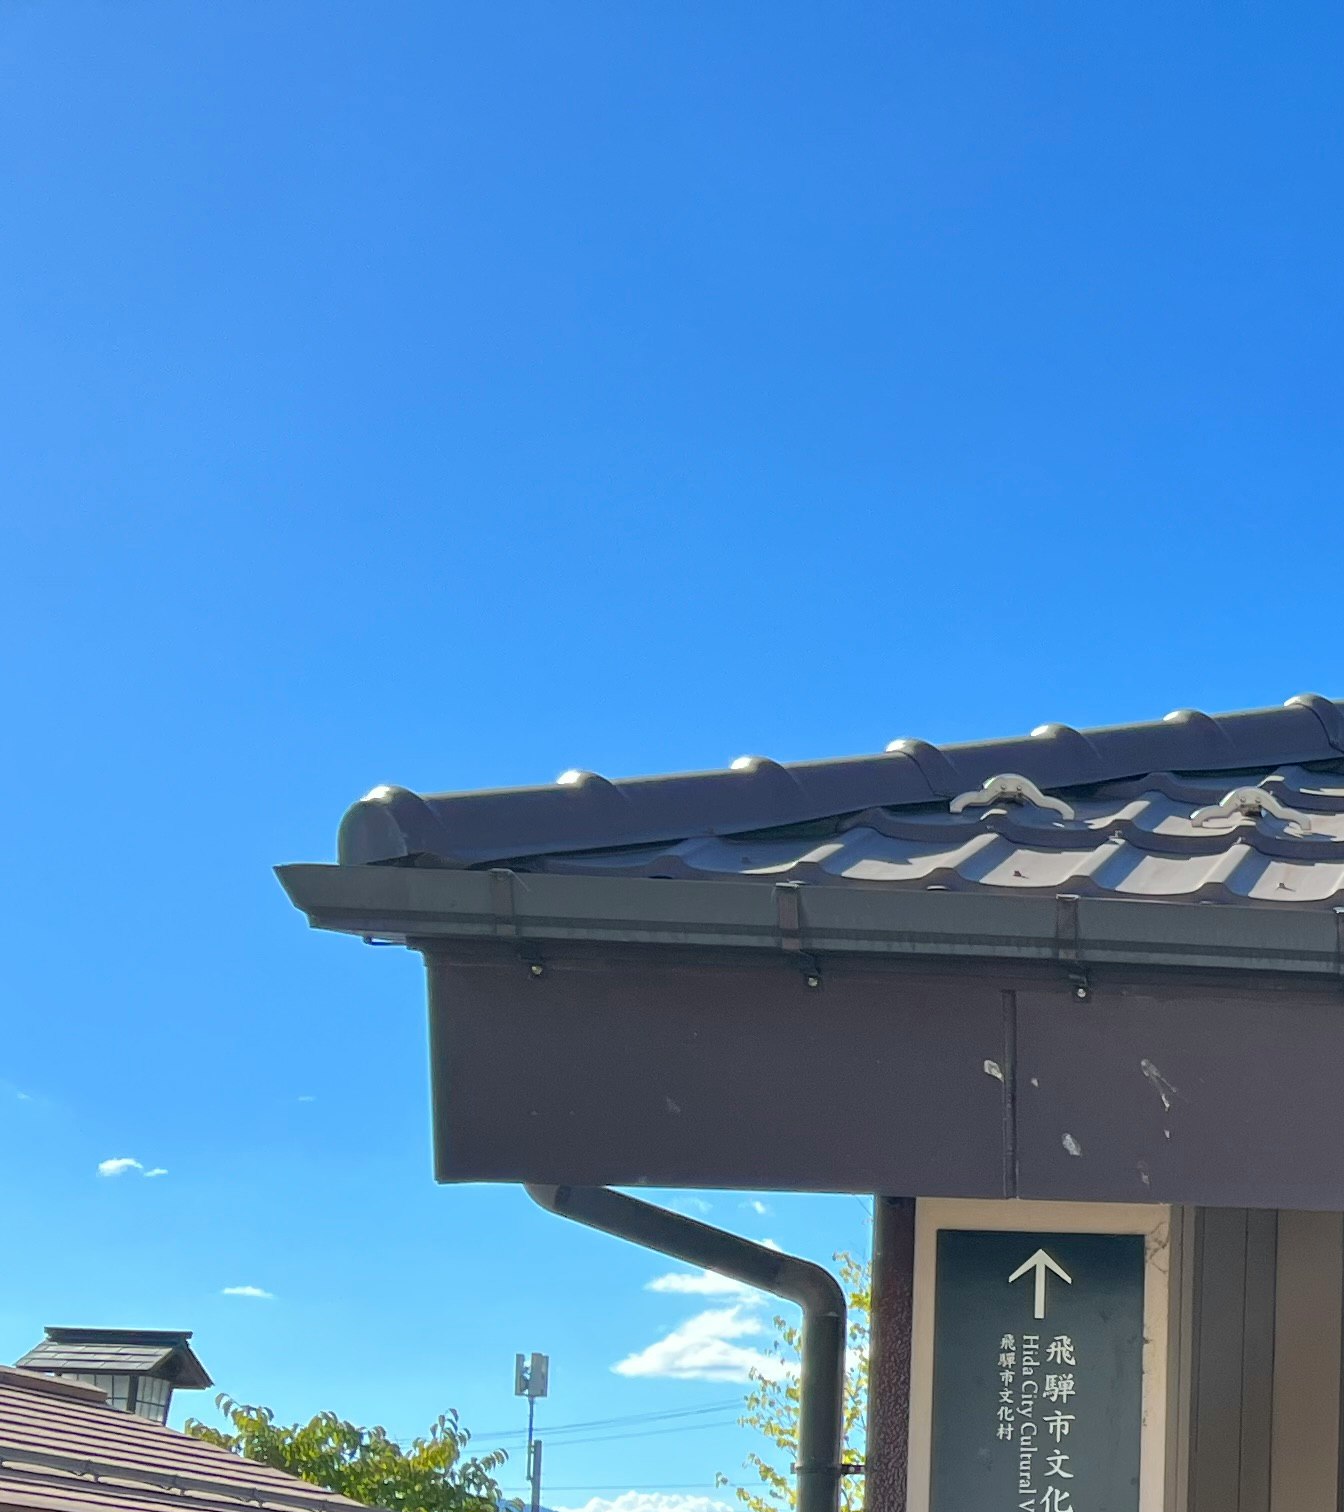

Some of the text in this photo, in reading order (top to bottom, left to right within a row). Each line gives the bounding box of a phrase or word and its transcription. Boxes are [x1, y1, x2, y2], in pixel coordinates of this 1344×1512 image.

[1022, 1335, 1040, 1376] Hida
[1016, 1380, 1039, 1418] City
[1018, 1422, 1038, 1494] Cultural
